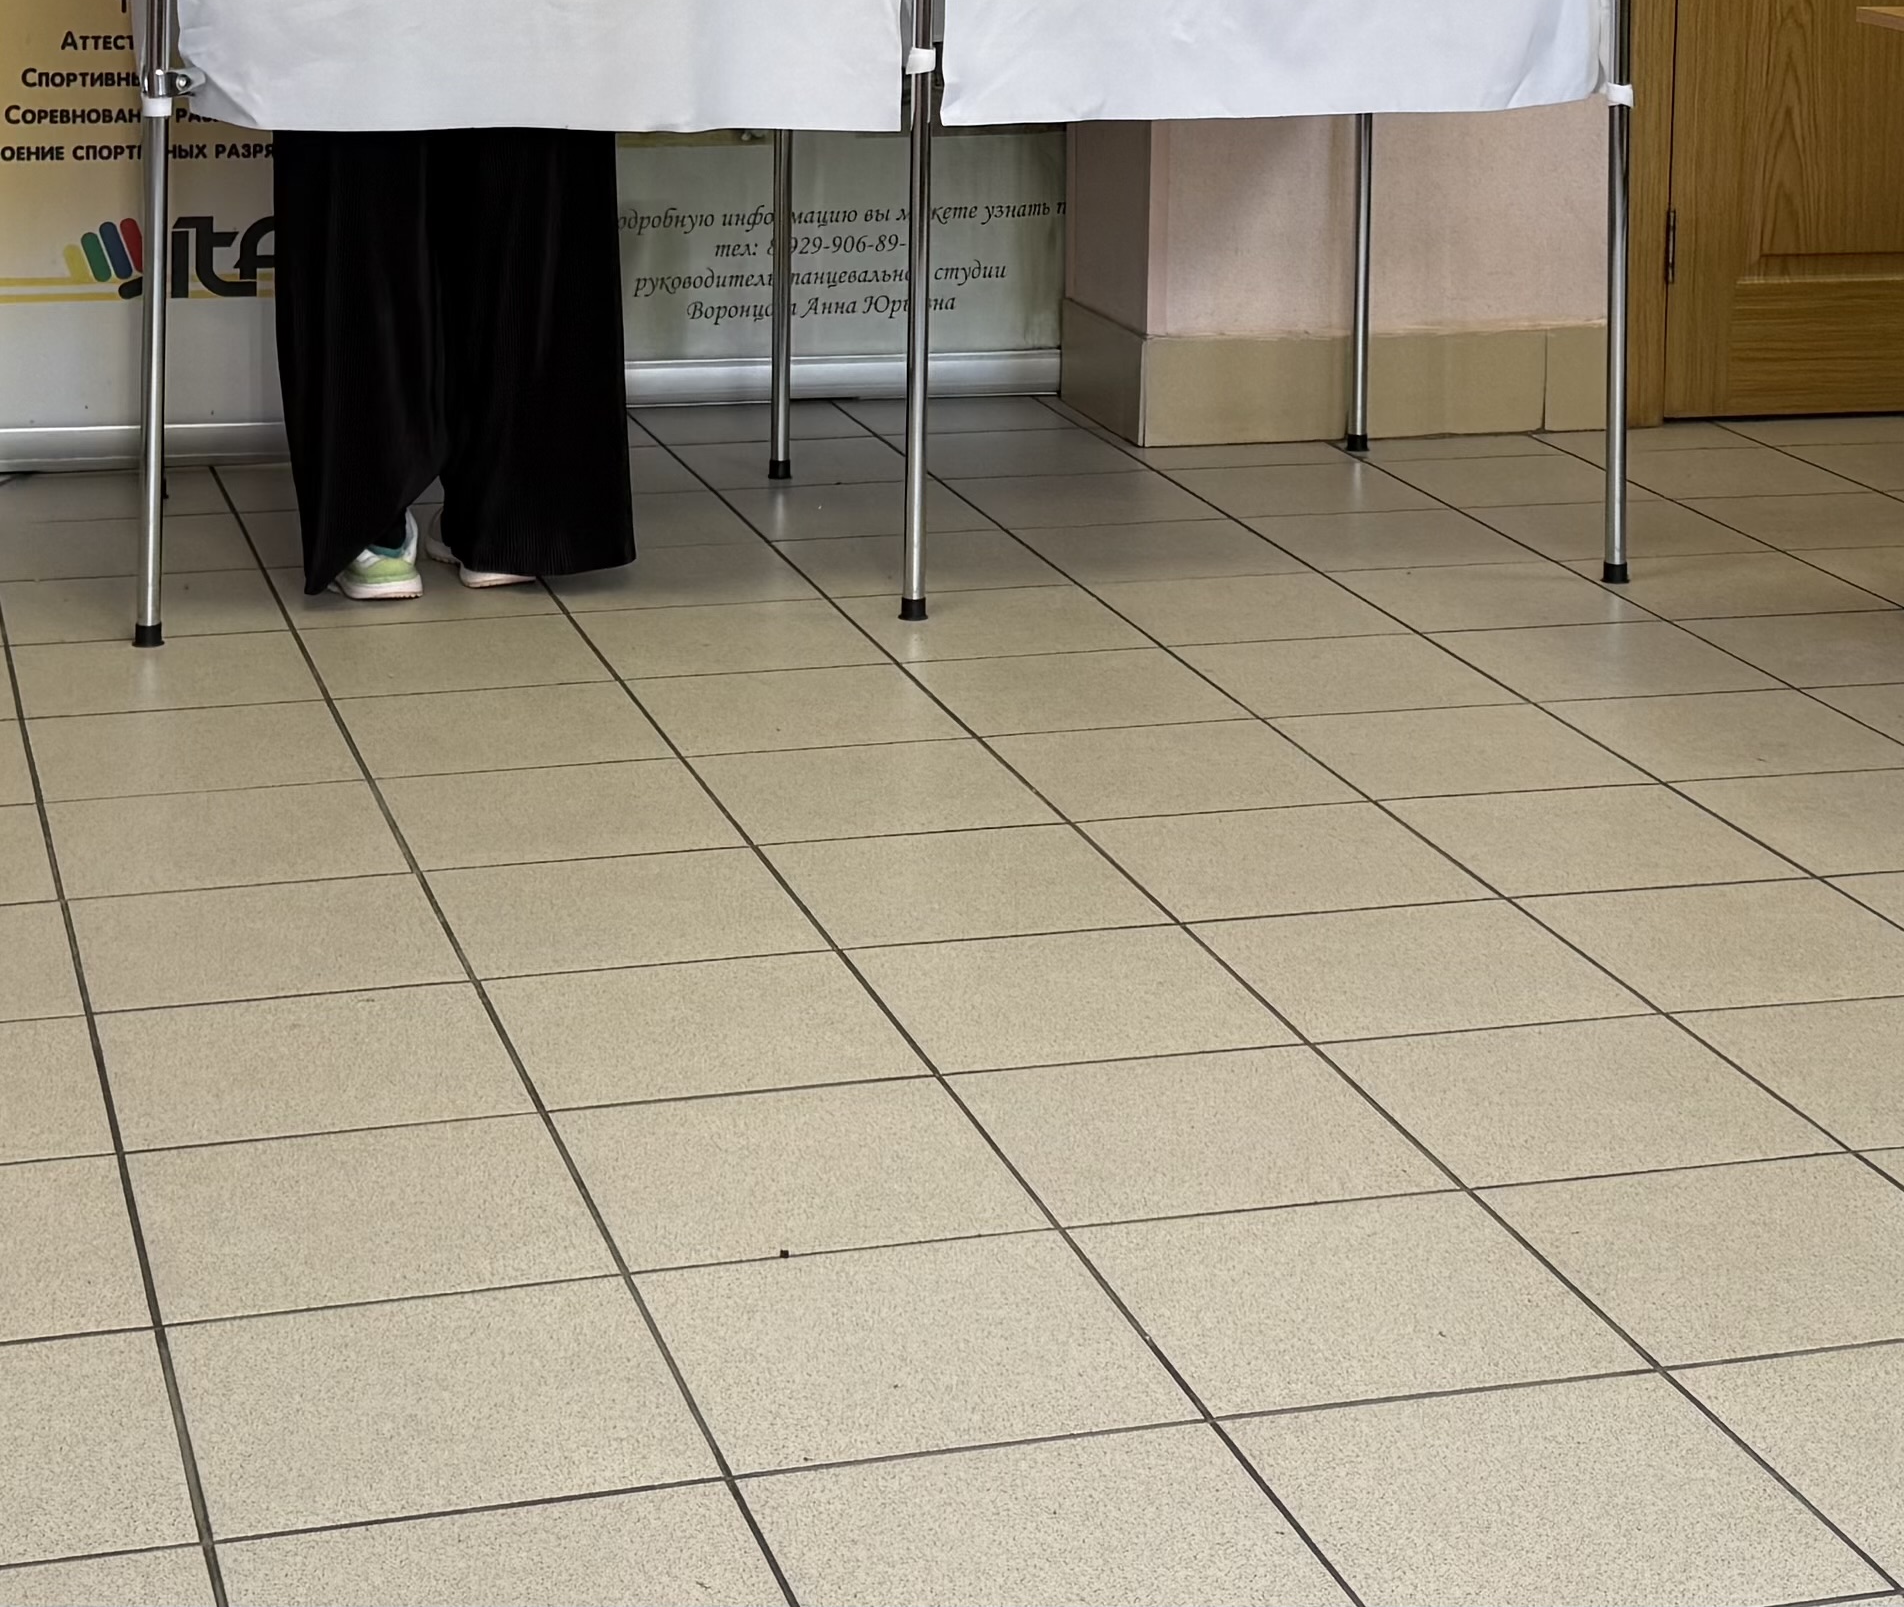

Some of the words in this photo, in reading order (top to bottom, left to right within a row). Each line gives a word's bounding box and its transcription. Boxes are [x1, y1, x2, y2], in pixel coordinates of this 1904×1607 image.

[617, 207, 715, 236] одробную
[722, 205, 858, 233] инфомацию
[864, 208, 890, 222] вы
[896, 205, 978, 225] мжете
[981, 202, 1051, 225] узнать
[715, 242, 758, 258] тел:
[790, 268, 911, 289] танцевально
[934, 259, 1007, 286] студии
[686, 300, 796, 324] Воронцо
[800, 296, 857, 319] Анна
[862, 295, 956, 319] Юрьна
